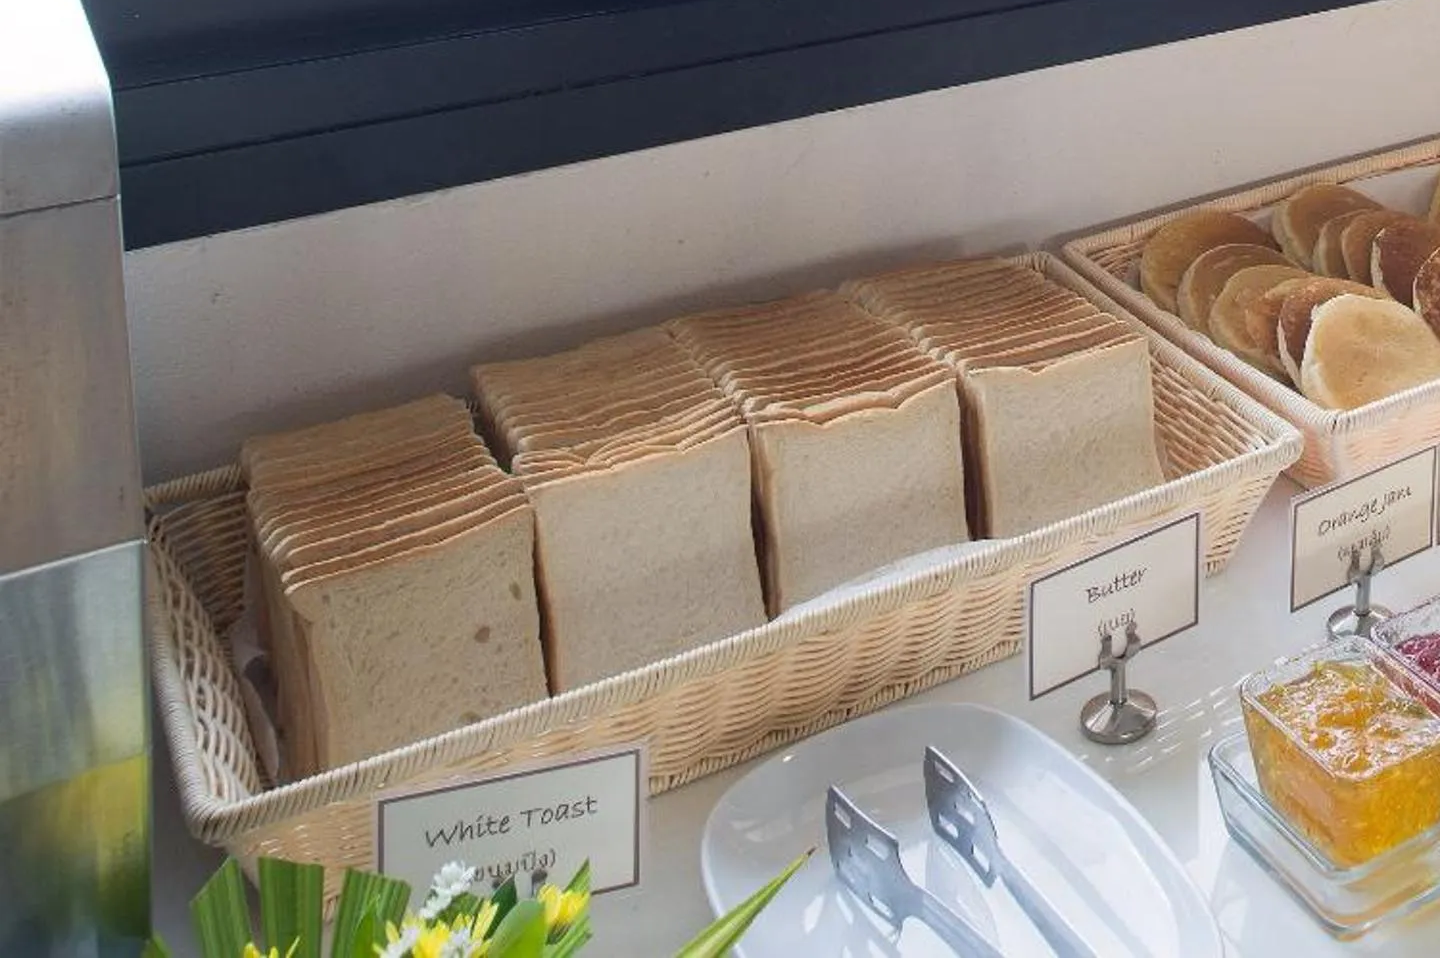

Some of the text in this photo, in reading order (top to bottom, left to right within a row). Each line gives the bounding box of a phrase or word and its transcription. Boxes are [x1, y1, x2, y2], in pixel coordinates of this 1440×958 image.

[1317, 498, 1378, 536] Orange
[1085, 567, 1148, 604] Butter
[425, 796, 598, 848] White Toast
